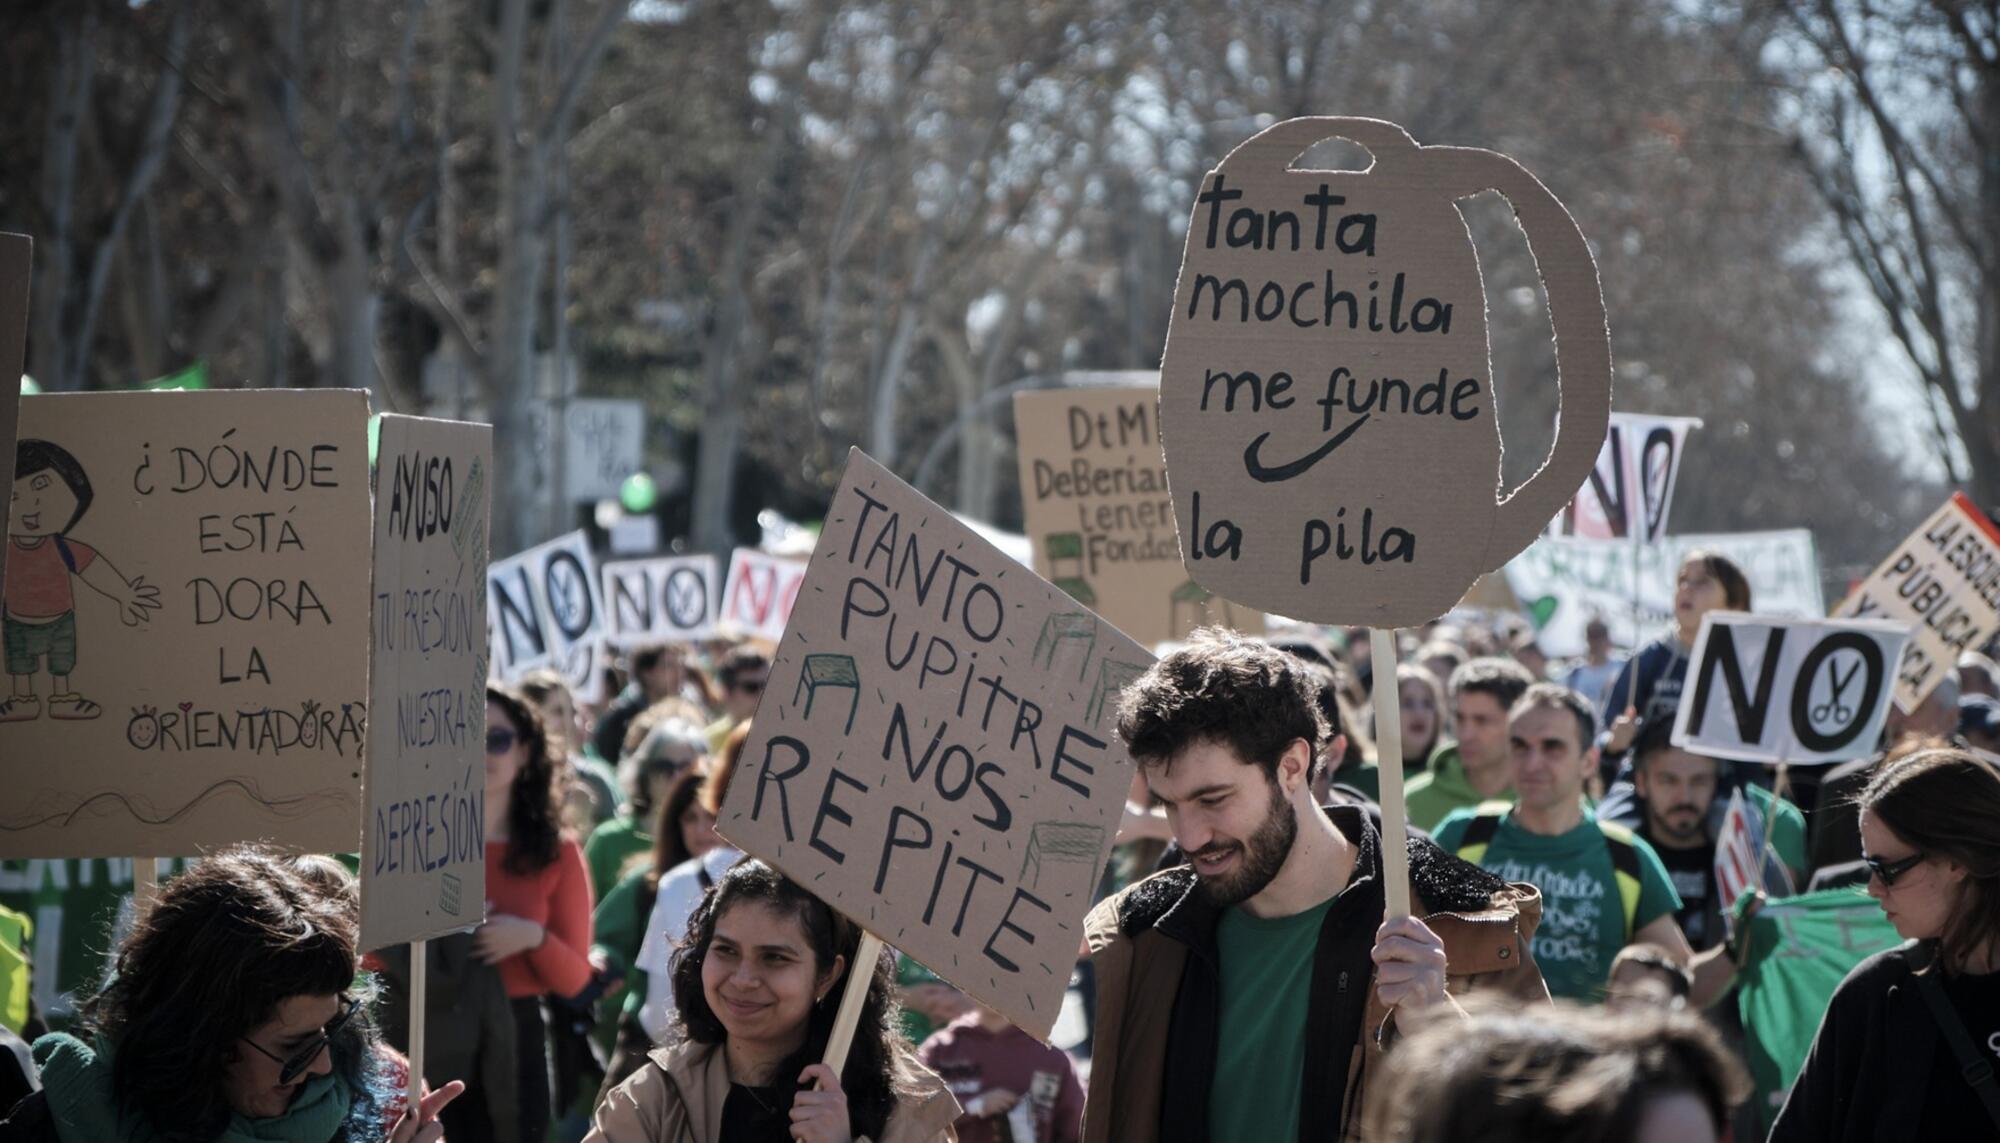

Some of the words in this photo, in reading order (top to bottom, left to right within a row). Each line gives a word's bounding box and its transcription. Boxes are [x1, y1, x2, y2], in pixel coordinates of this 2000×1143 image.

[1200, 174, 1377, 257] tanta
[1187, 269, 1453, 334] mochila
[1068, 402, 1163, 452] DtM
[1200, 367, 1294, 413] me
[1316, 366, 1481, 432] funde
[199, 506, 305, 554] ESTÁ
[388, 449, 453, 544] AYUSO
[1191, 491, 1243, 561] la
[1301, 507, 1416, 585] pila
[184, 577, 333, 626] DORA
[612, 566, 708, 634] NO
[853, 485, 1005, 643] TANTO
[1882, 552, 1980, 653] PÚBLICA
[377, 592, 394, 652] TU
[402, 562, 473, 654] PRESIÓN
[489, 549, 594, 667] NO
[219, 646, 272, 685] LA
[1686, 622, 1885, 754] NO
[398, 689, 466, 750] NUESTRA
[883, 701, 1012, 832] NOS
[375, 764, 484, 877] DEPRESIÓN
